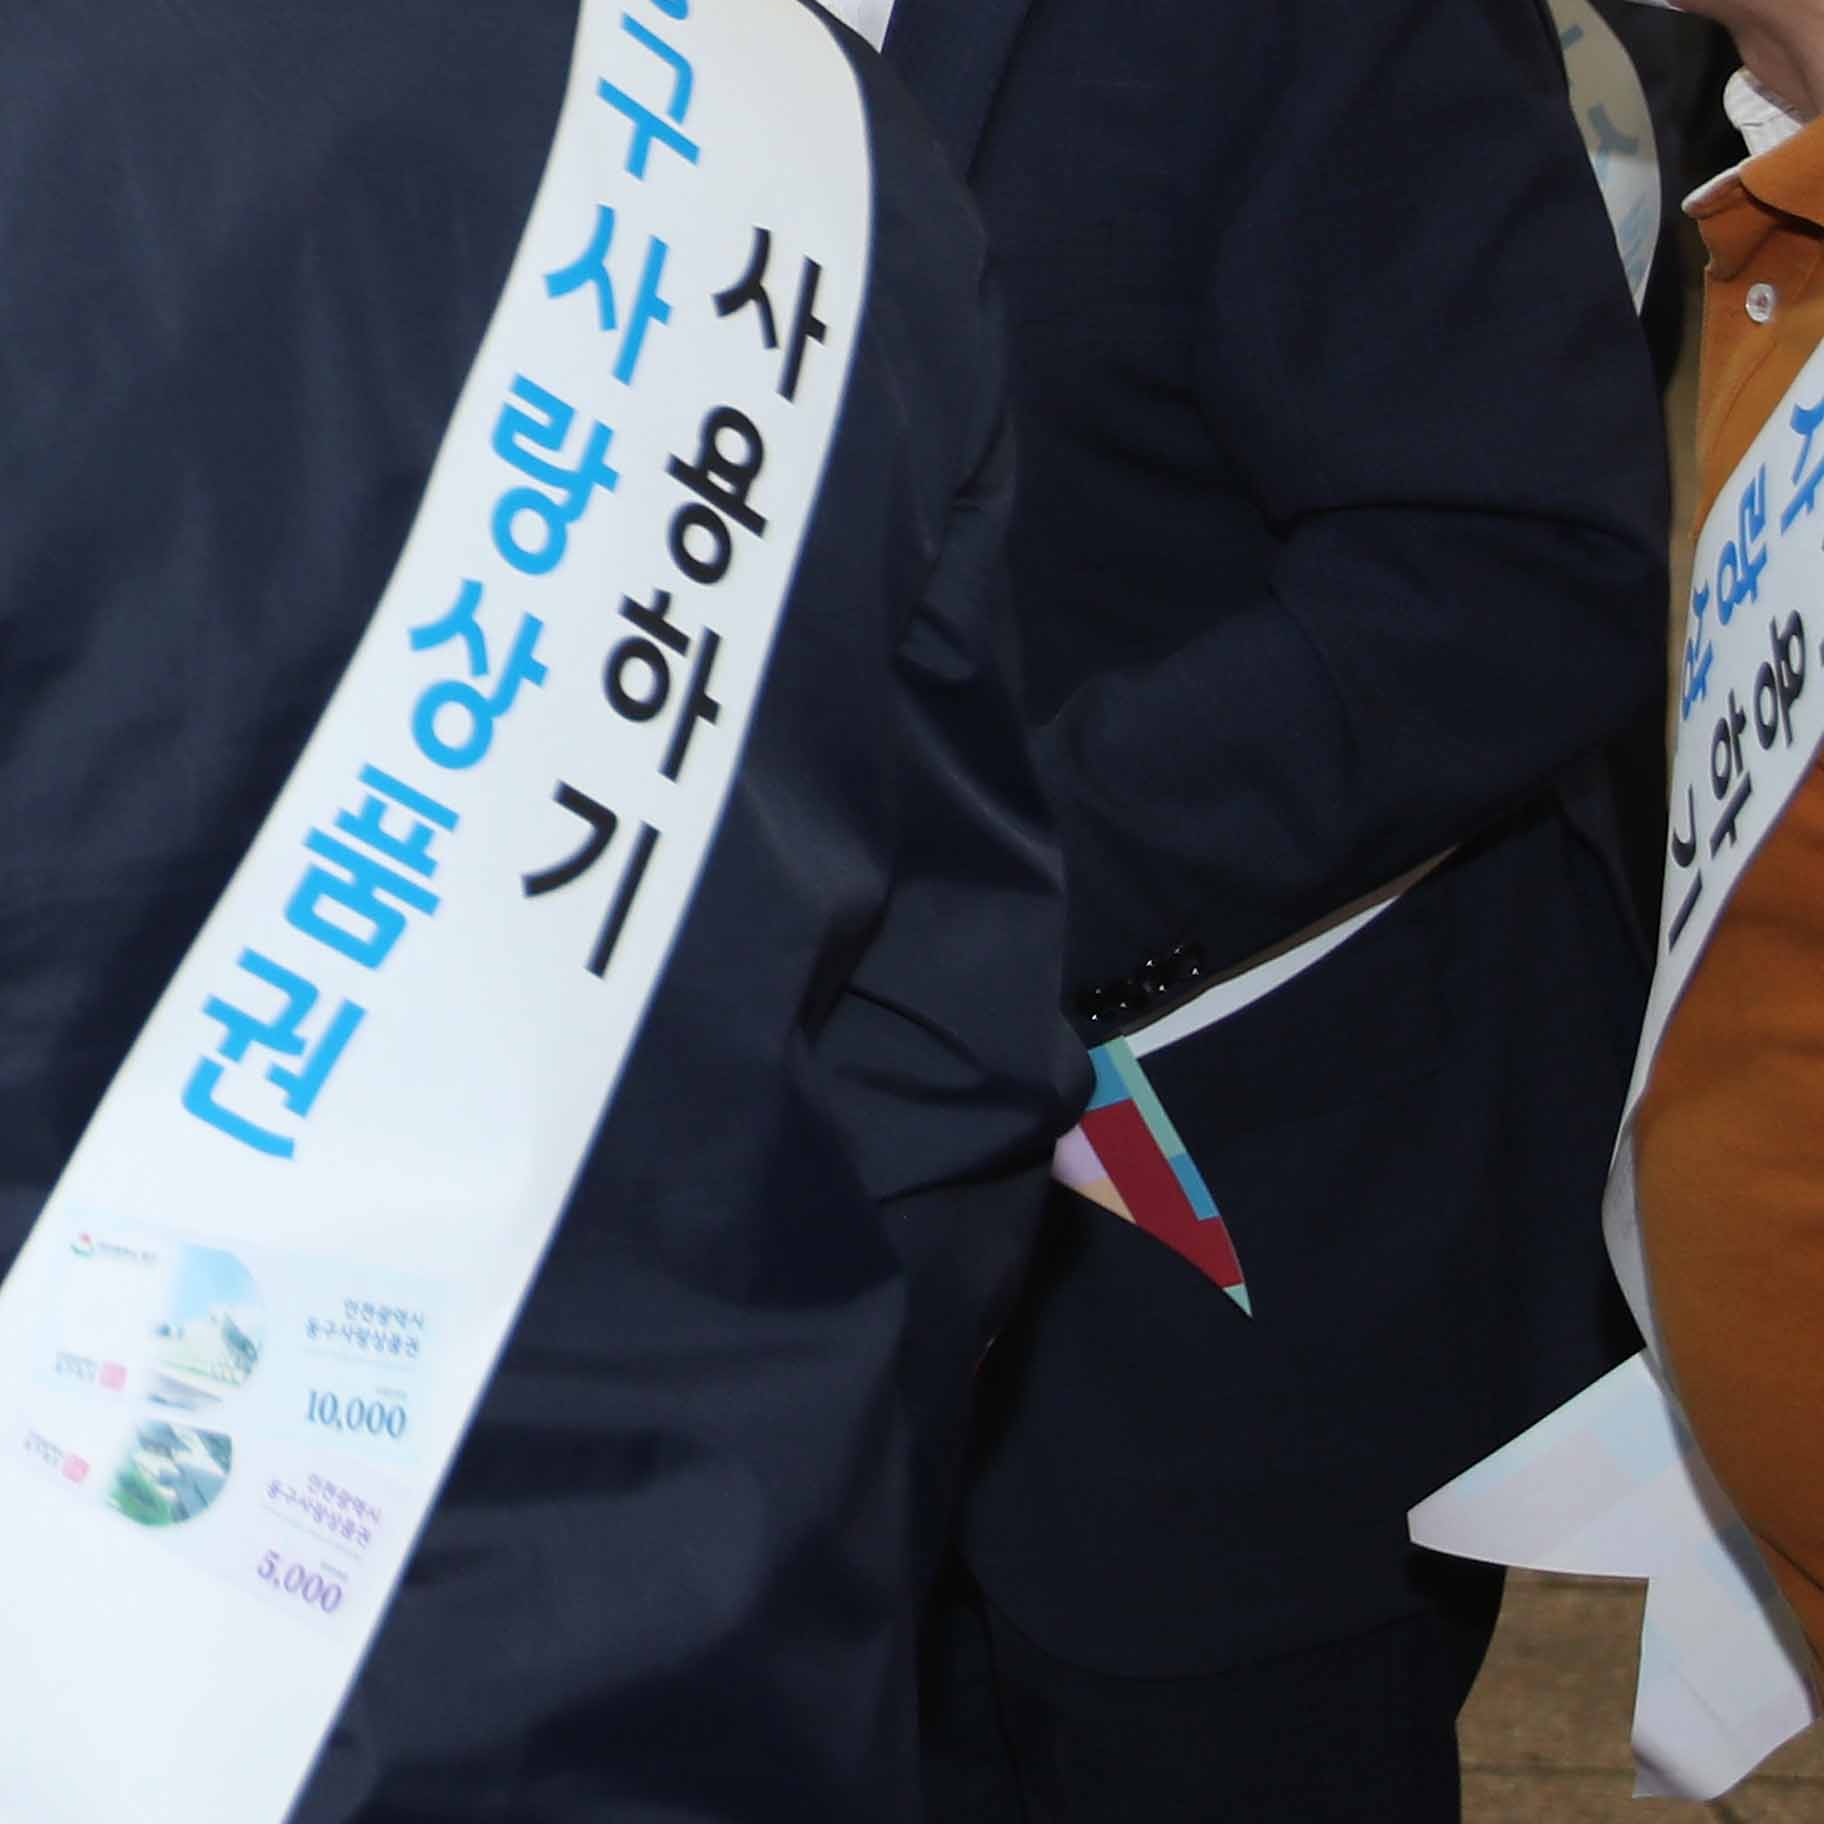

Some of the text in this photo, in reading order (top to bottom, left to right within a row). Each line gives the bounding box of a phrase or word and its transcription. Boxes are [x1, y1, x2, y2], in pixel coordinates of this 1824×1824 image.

[523, 226, 832, 978] 사용하기
[1669, 576, 1824, 952] 용하기
[305, 1388, 408, 1441] 10,000
[255, 1548, 345, 1615] 5,000
